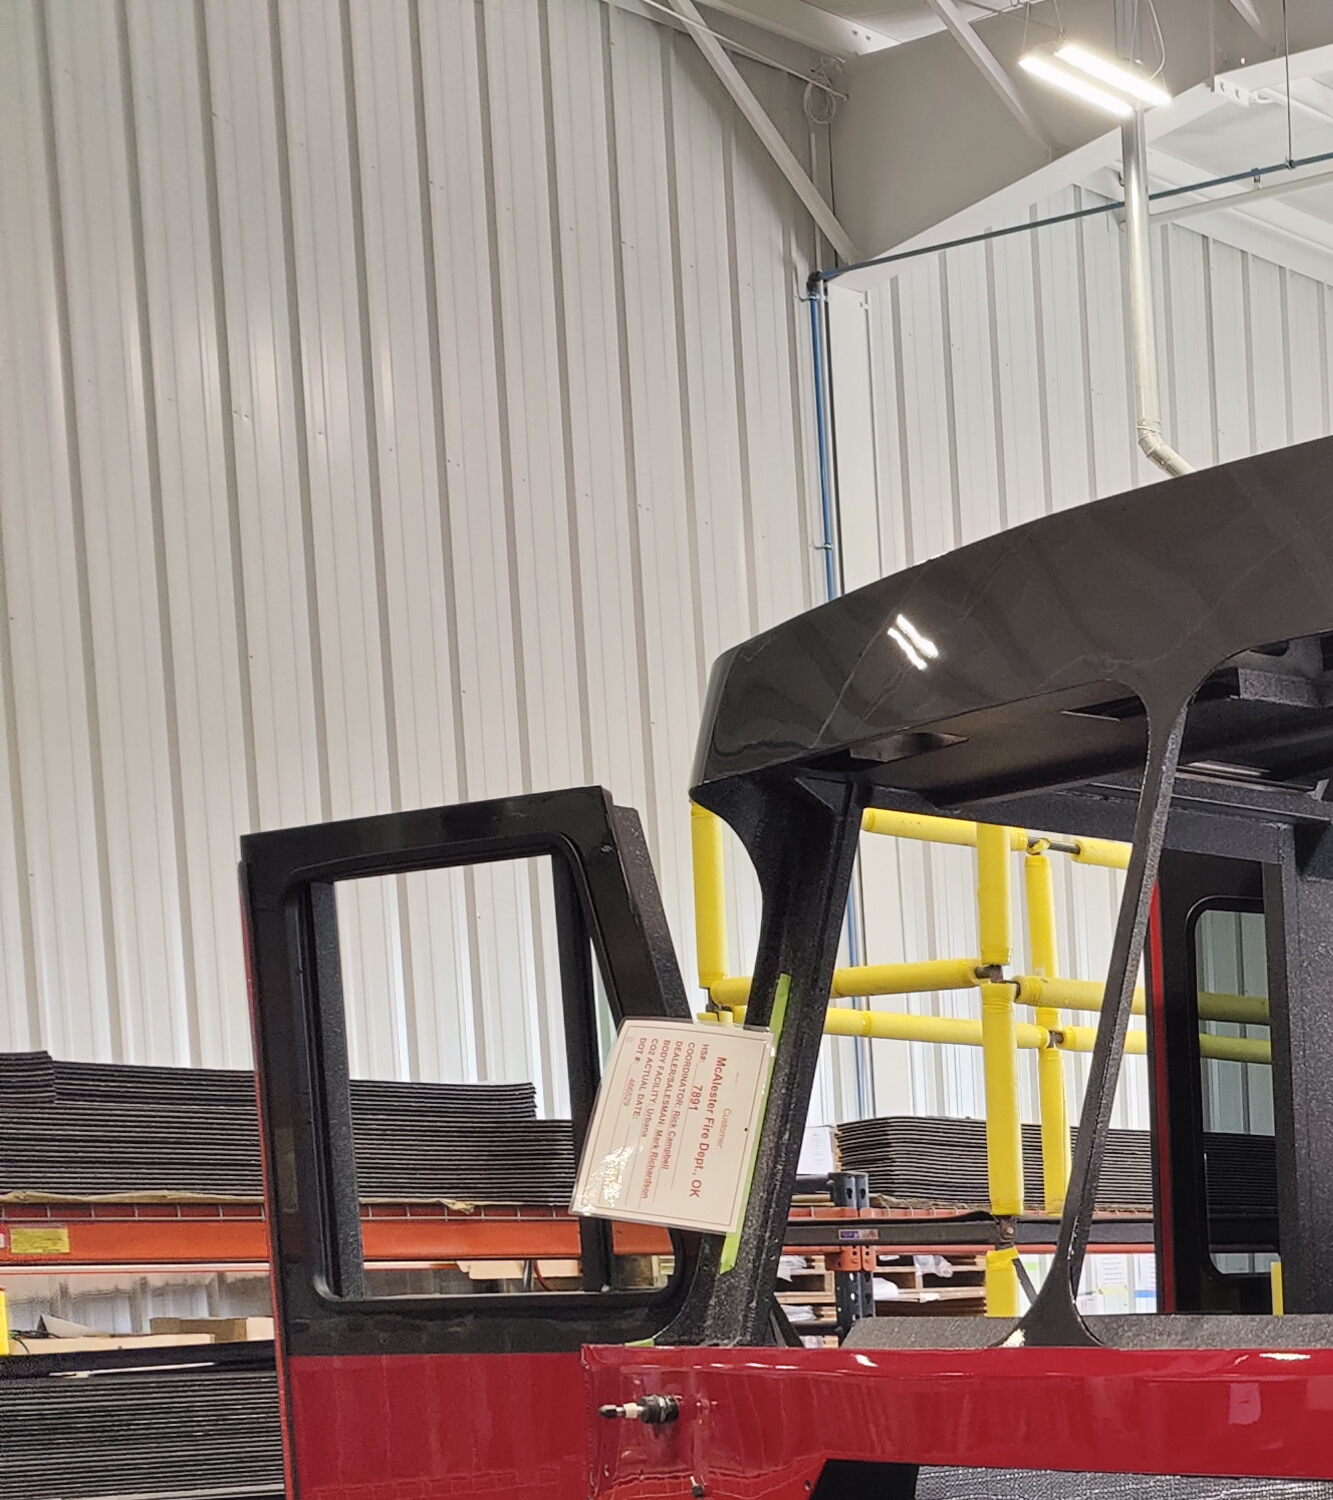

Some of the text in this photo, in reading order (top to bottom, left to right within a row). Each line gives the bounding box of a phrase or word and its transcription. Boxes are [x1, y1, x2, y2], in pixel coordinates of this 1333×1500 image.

[636, 1037, 648, 1055] DOT
[632, 1038, 659, 1120] CO2 ACTUAL DATE:
[641, 1039, 672, 1138] BODY FACILITY: Urbana
[661, 1041, 696, 1170] COORDINATOR: Rick Campbell
[688, 1084, 702, 1112] 7891
[709, 1056, 728, 1116] McAlester
[641, 1040, 684, 1199] DEALER/SALESMAN: Mark Richardson
[701, 1117, 715, 1140] Fire
[689, 1179, 702, 1198] OK
